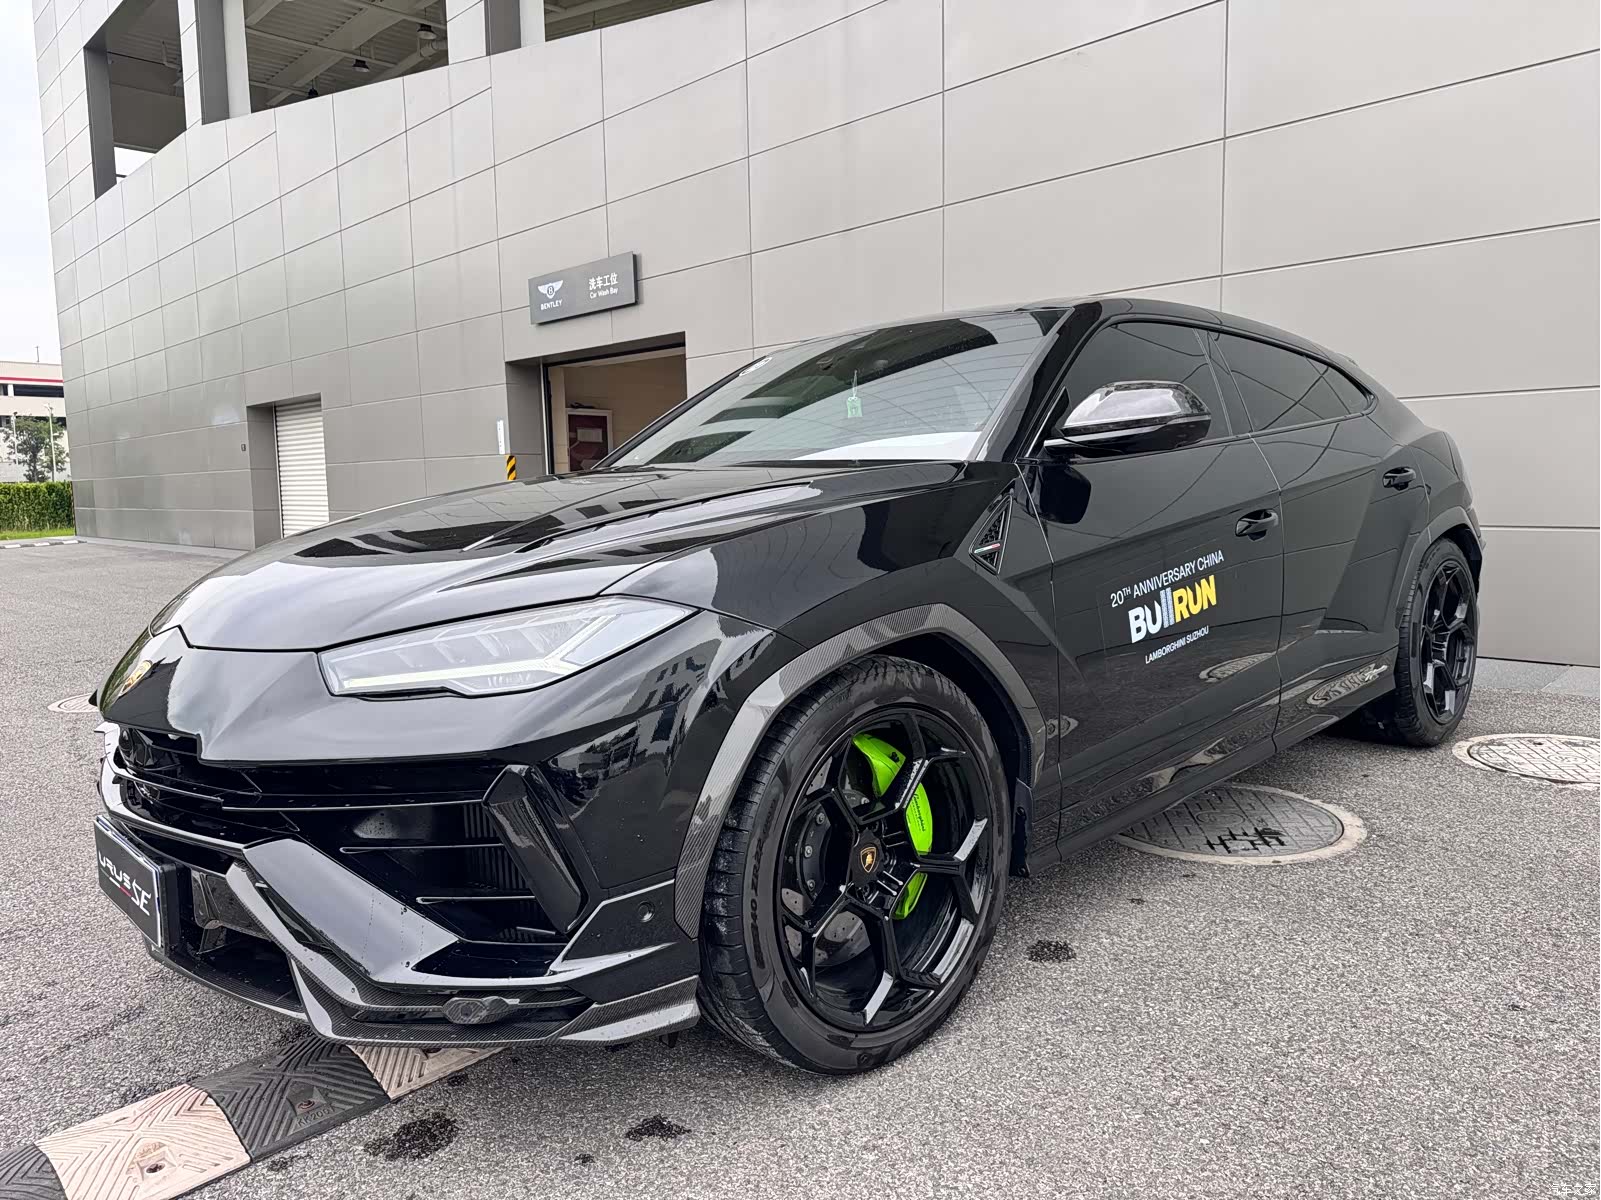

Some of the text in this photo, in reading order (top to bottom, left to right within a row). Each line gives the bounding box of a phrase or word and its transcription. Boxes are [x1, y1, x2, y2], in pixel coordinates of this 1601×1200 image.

[589, 272, 618, 290] 洗车工位
[598, 288, 609, 297] Wash
[610, 287, 618, 295] Bay
[541, 299, 562, 310] BENTLEY
[1133, 560, 1196, 599] ANNIVERSARY
[1197, 550, 1224, 571] CHINA
[1145, 625, 1209, 664] LAMBORGHINI SUZHOU
[131, 879, 152, 917] SE
